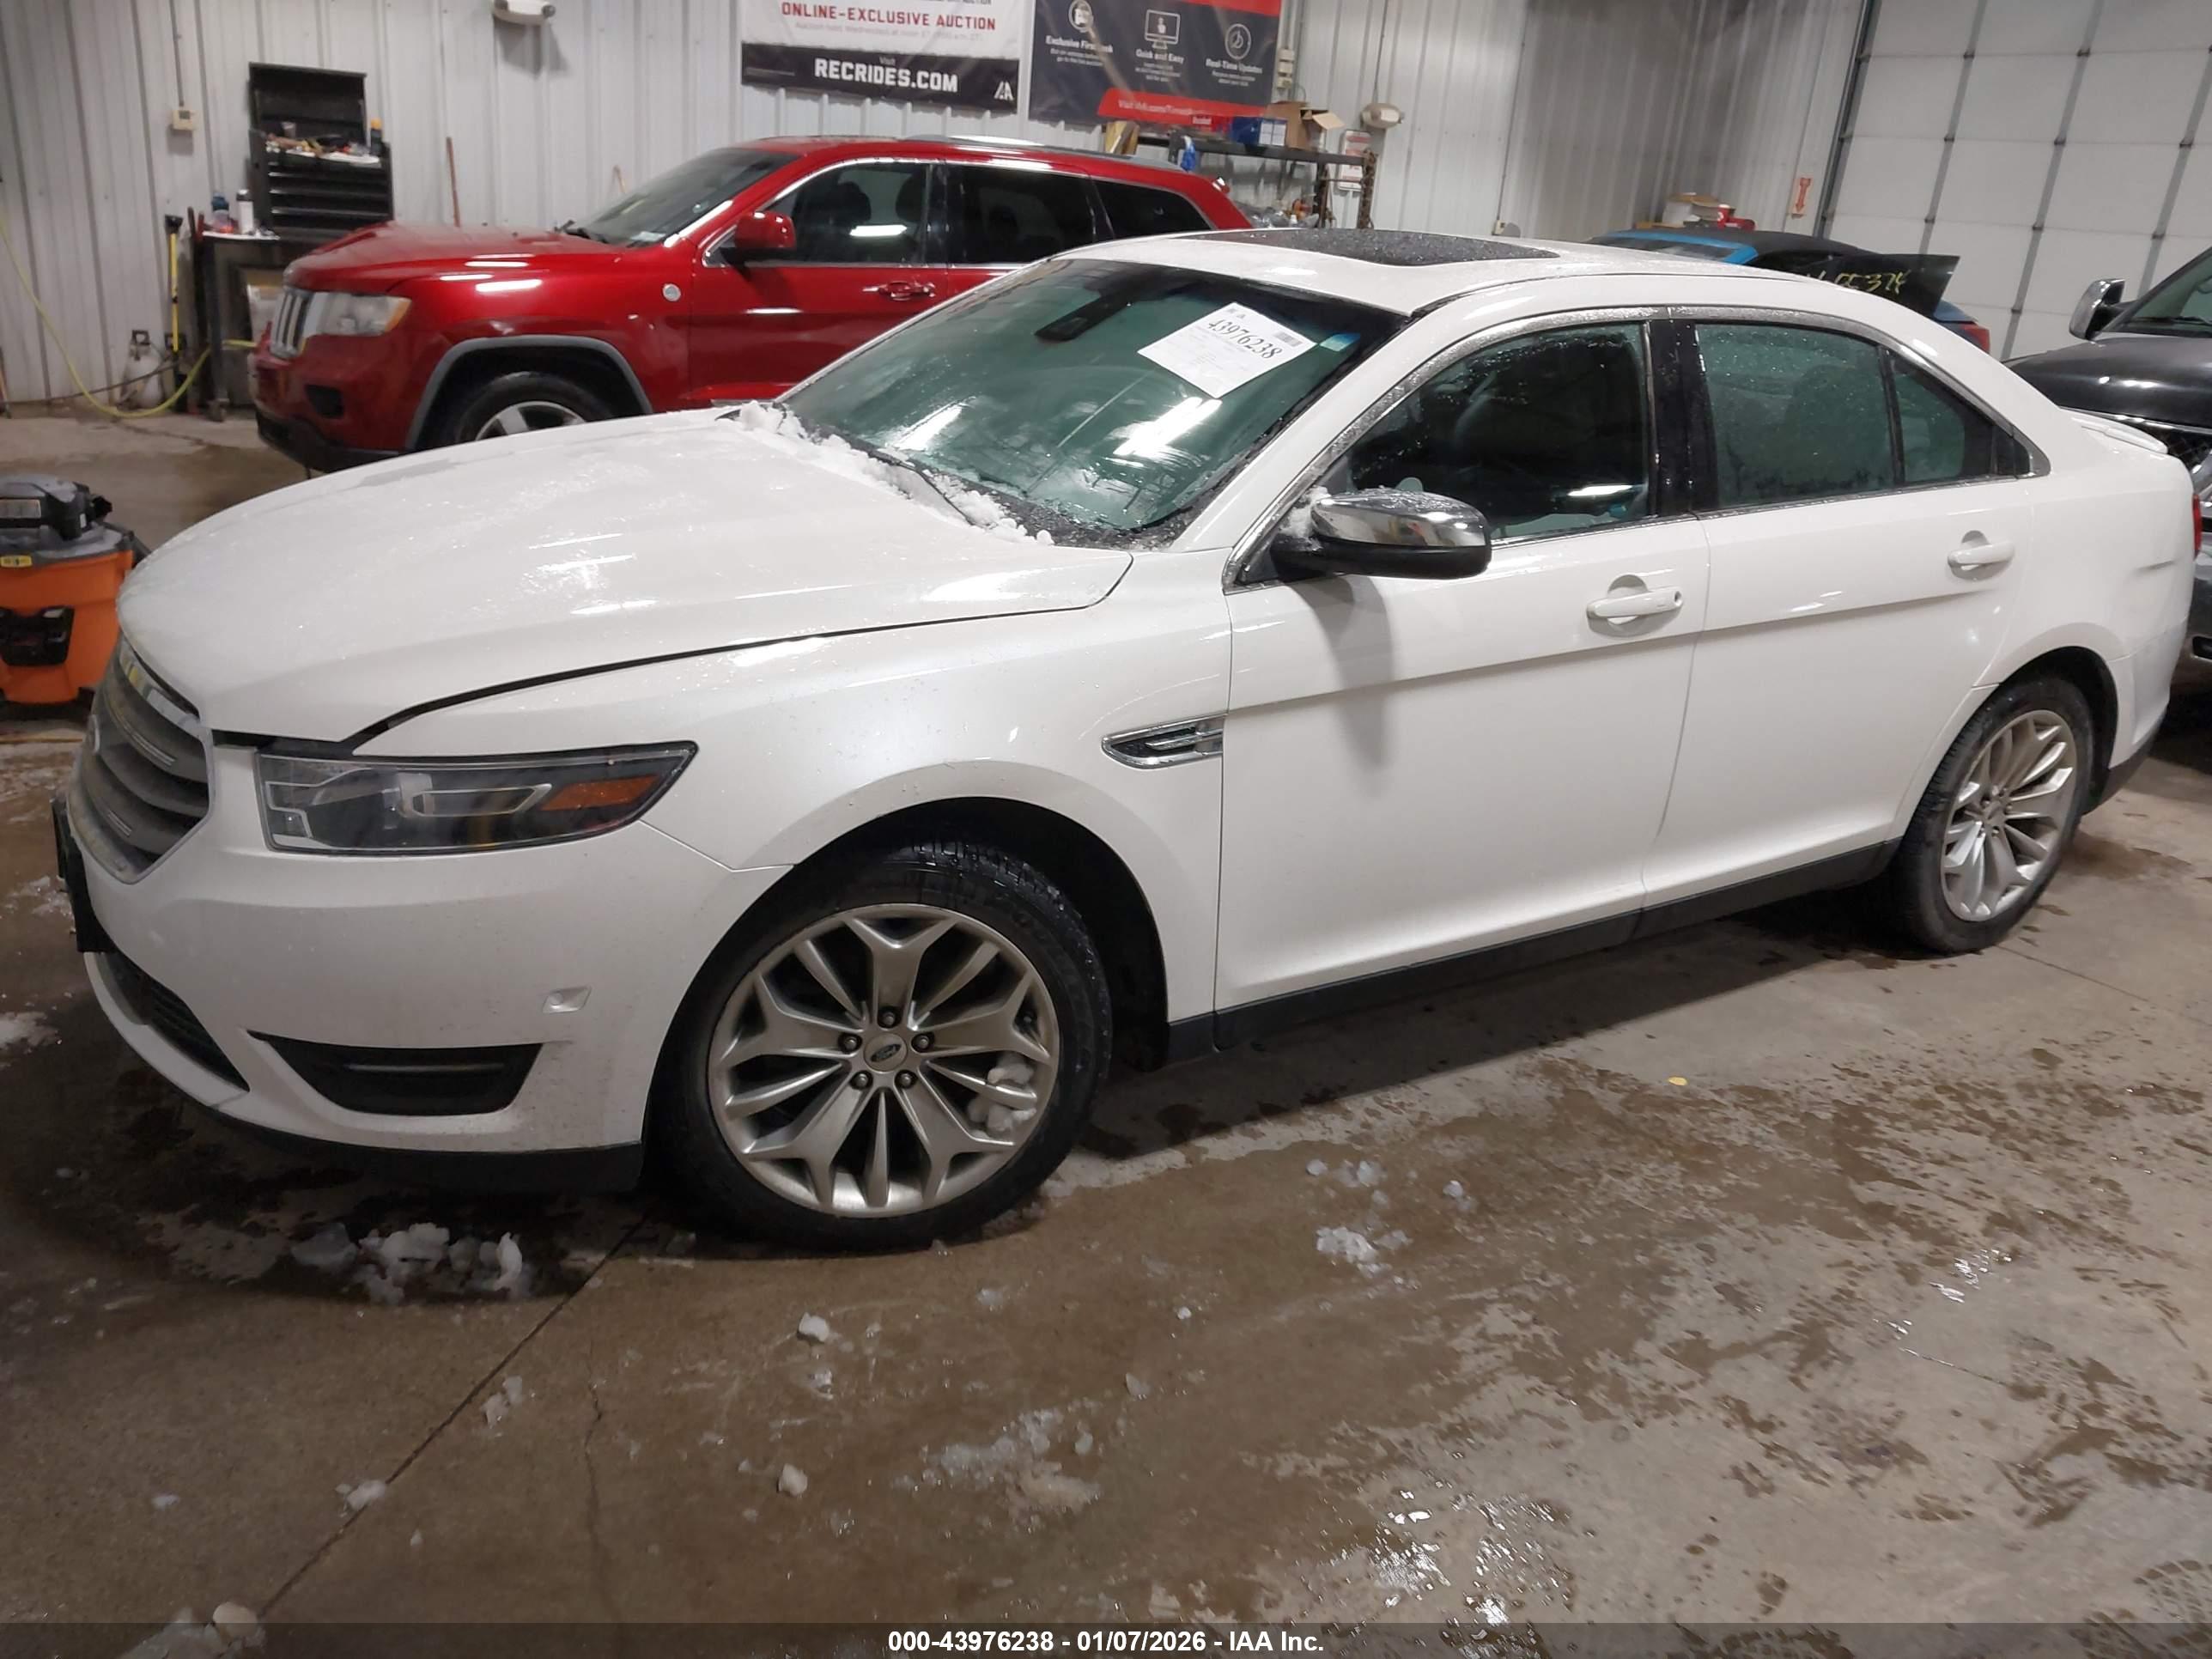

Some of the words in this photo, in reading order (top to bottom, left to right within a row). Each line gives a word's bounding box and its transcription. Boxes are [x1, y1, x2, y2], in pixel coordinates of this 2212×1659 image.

[781, 2, 930, 26] ONLINE-EXCLUSIVE
[936, 15, 996, 31] AUCTION
[814, 58, 958, 93] RECRIDES.COM
[1208, 319, 1283, 359] 43976238
